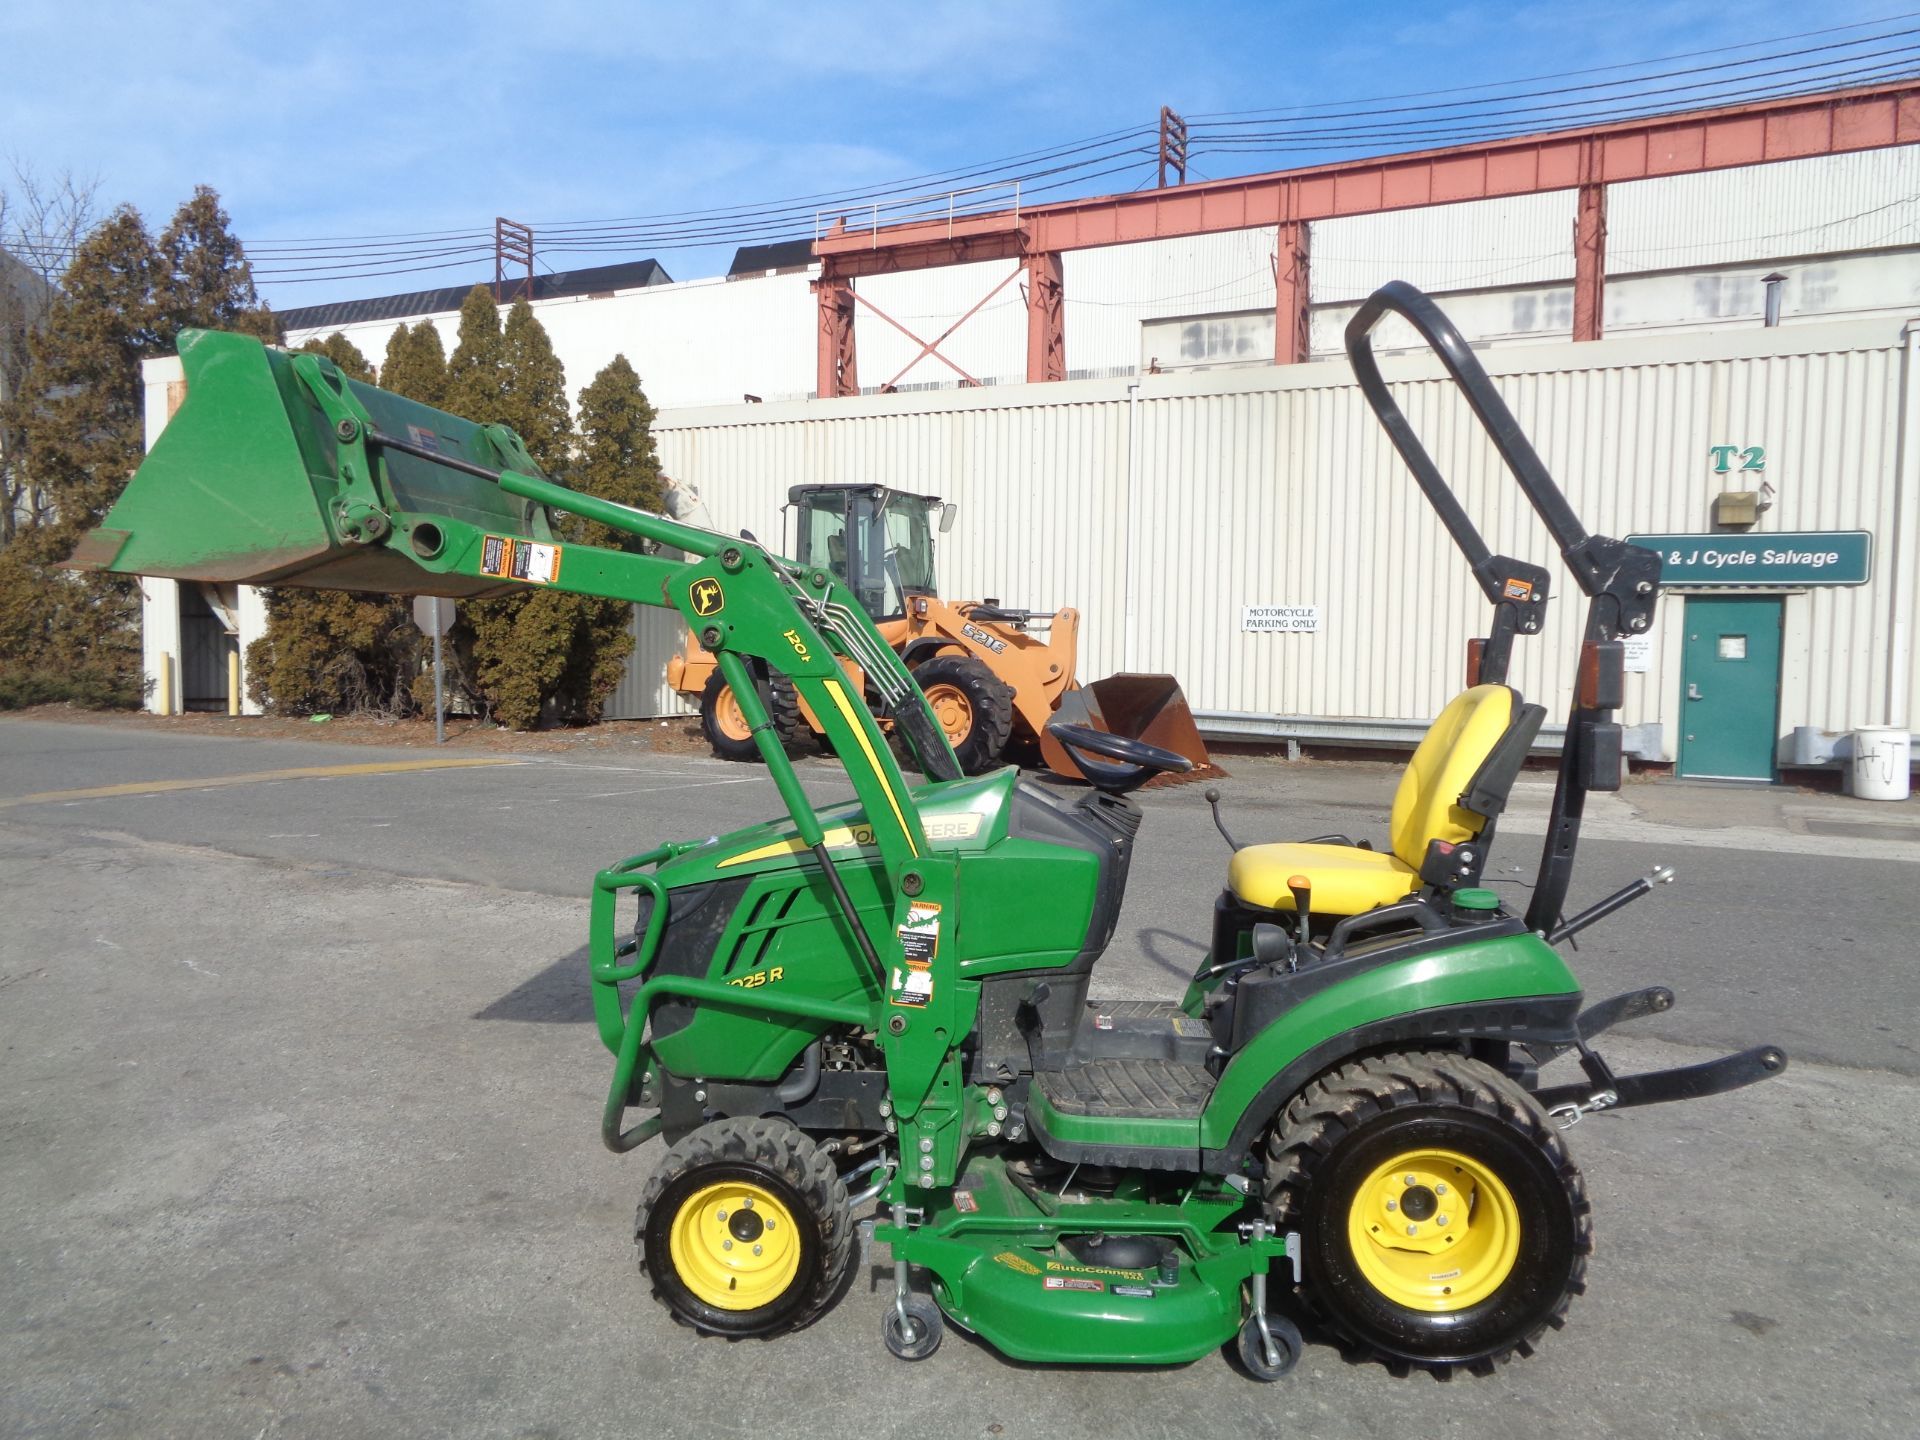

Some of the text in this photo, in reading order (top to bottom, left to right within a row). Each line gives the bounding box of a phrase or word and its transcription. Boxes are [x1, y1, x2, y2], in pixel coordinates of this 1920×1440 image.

[1709, 444, 1767, 473] T2
[1668, 550, 1682, 565] &
[1686, 550, 1699, 565] J
[1703, 550, 1756, 568] Cycle
[1762, 550, 1839, 568] Salvage
[1249, 608, 1314, 617] MOTORCYCLE
[1246, 619, 1318, 628] PARKING ONLY
[960, 623, 1008, 655] 521E
[922, 822, 969, 837] EERE
[726, 966, 784, 988] 025 R
[1051, 1263, 1144, 1277] AutoConnect
